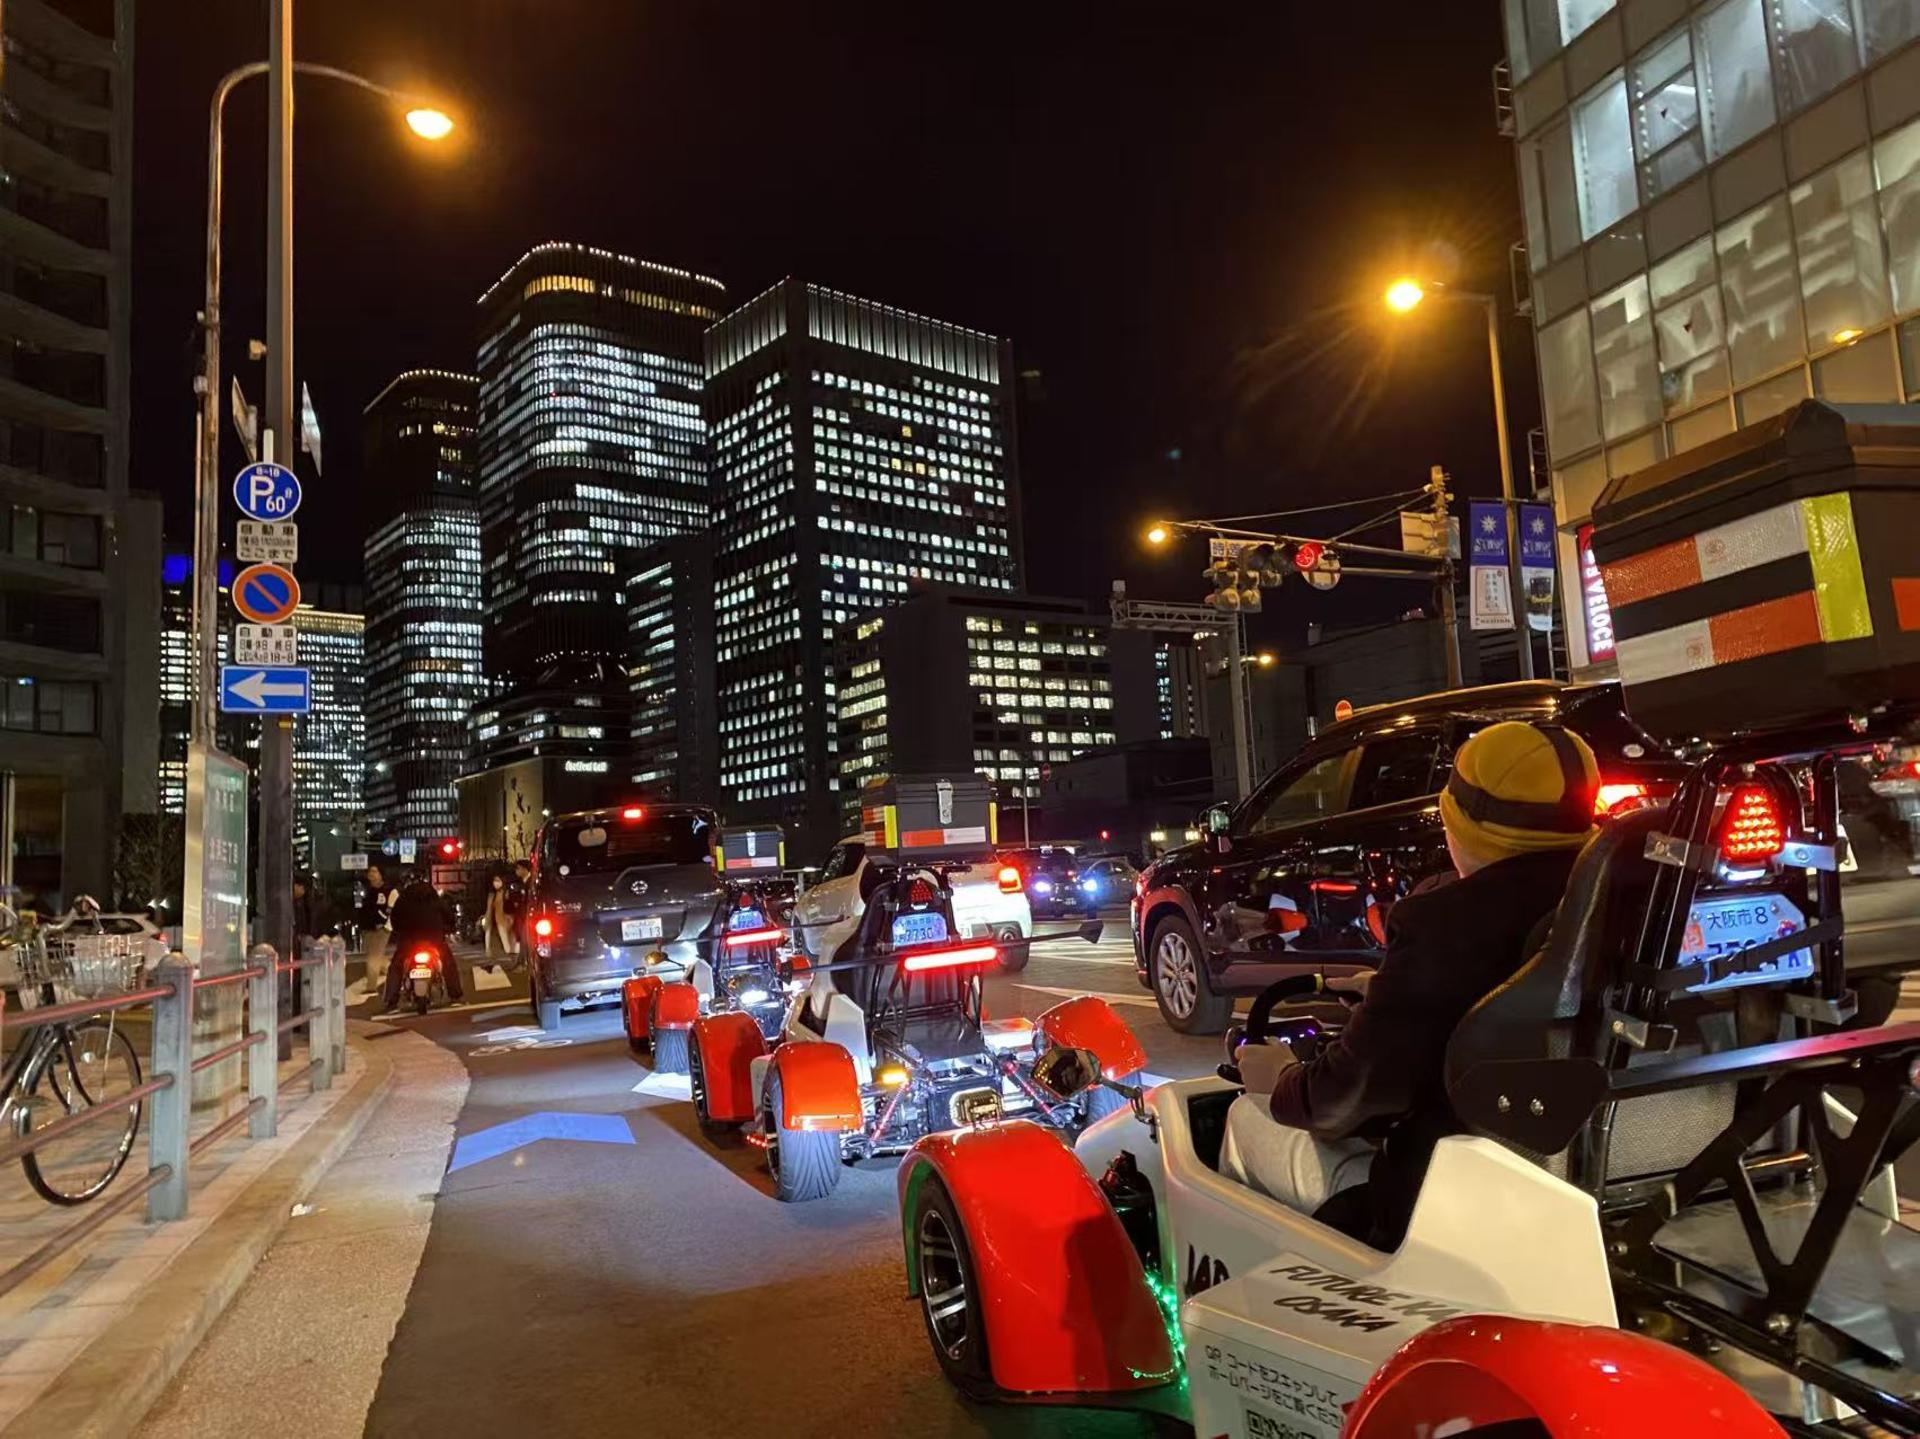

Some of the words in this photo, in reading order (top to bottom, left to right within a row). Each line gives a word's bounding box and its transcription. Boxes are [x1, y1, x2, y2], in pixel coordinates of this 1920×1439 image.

[250, 475, 275, 512] P
[265, 495, 286, 513] 60
[239, 626, 294, 638] 自動車
[1585, 582, 1614, 653] VELOCE
[1269, 1264, 1398, 1307] FUTURE
[1273, 1295, 1400, 1334] OSAKA
